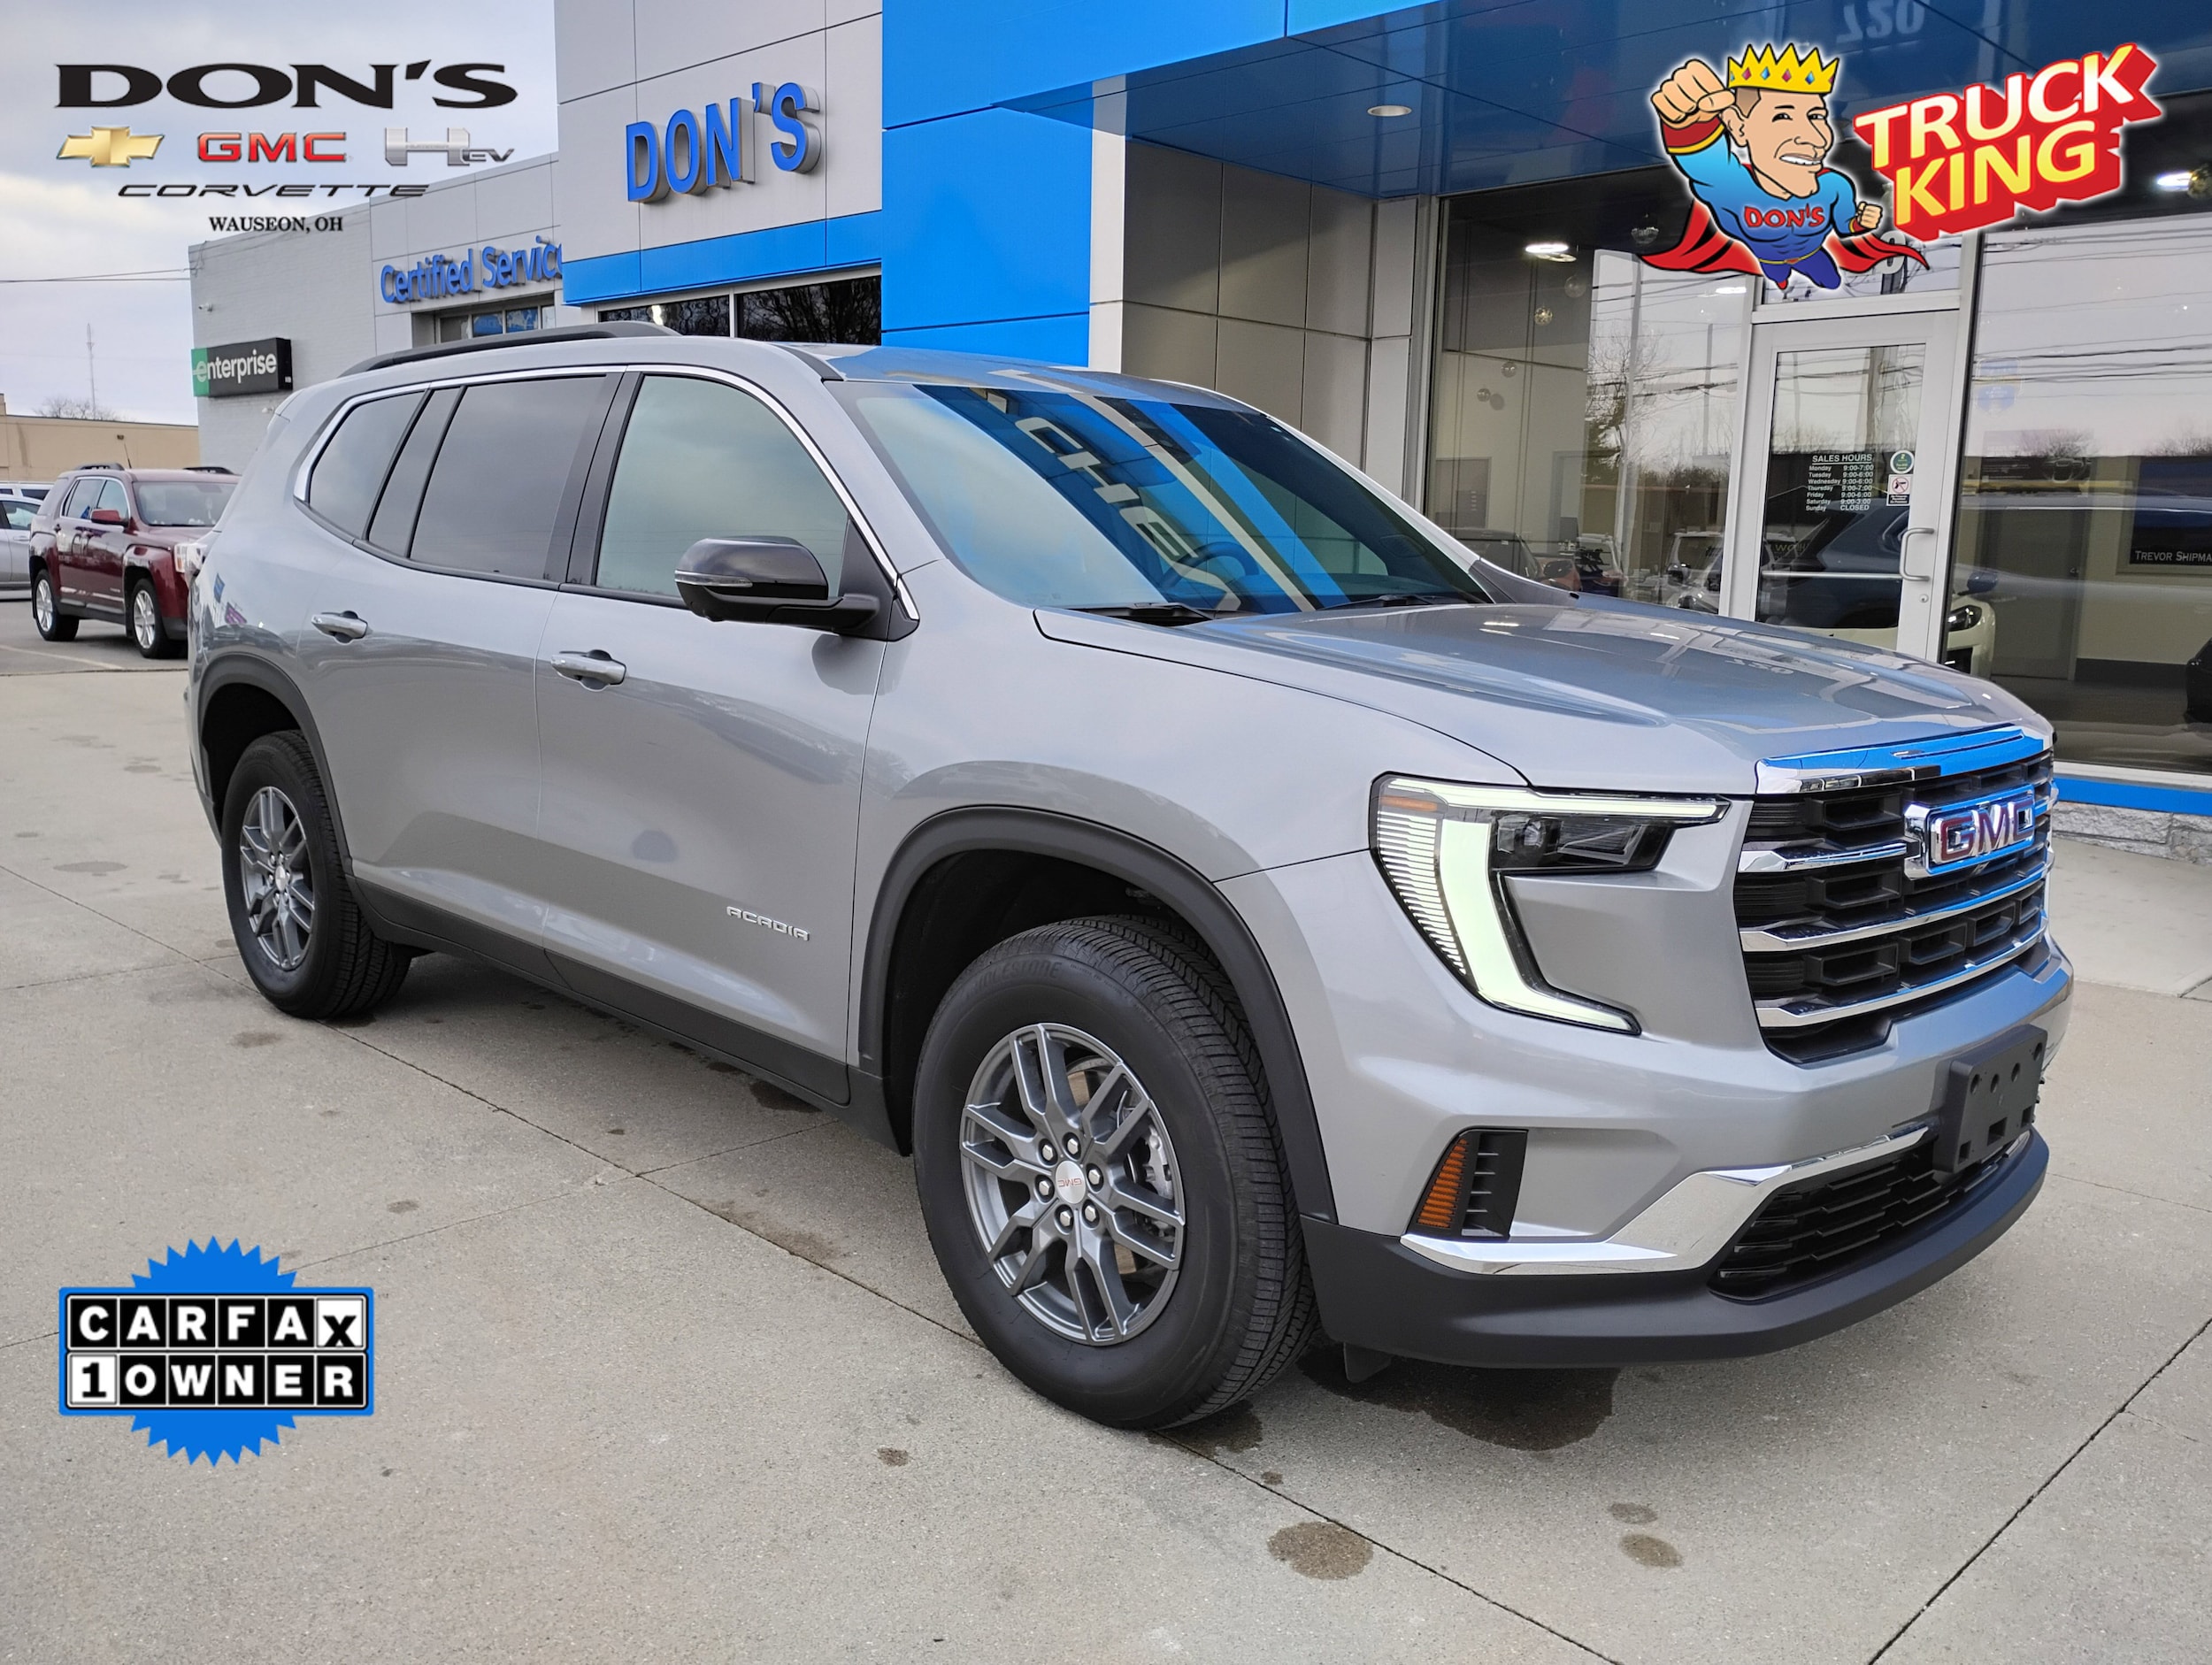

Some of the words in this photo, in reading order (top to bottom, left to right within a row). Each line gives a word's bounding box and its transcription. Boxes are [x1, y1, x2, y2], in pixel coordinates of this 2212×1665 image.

[626, 81, 816, 203] DON'S
[380, 249, 473, 303] Certified
[194, 349, 277, 384] enterprise
[2135, 550, 2173, 562] TREVOR
[1932, 796, 2035, 864] GMC
[726, 906, 810, 941] ACADIA
[1057, 1178, 1082, 1188] GMC
